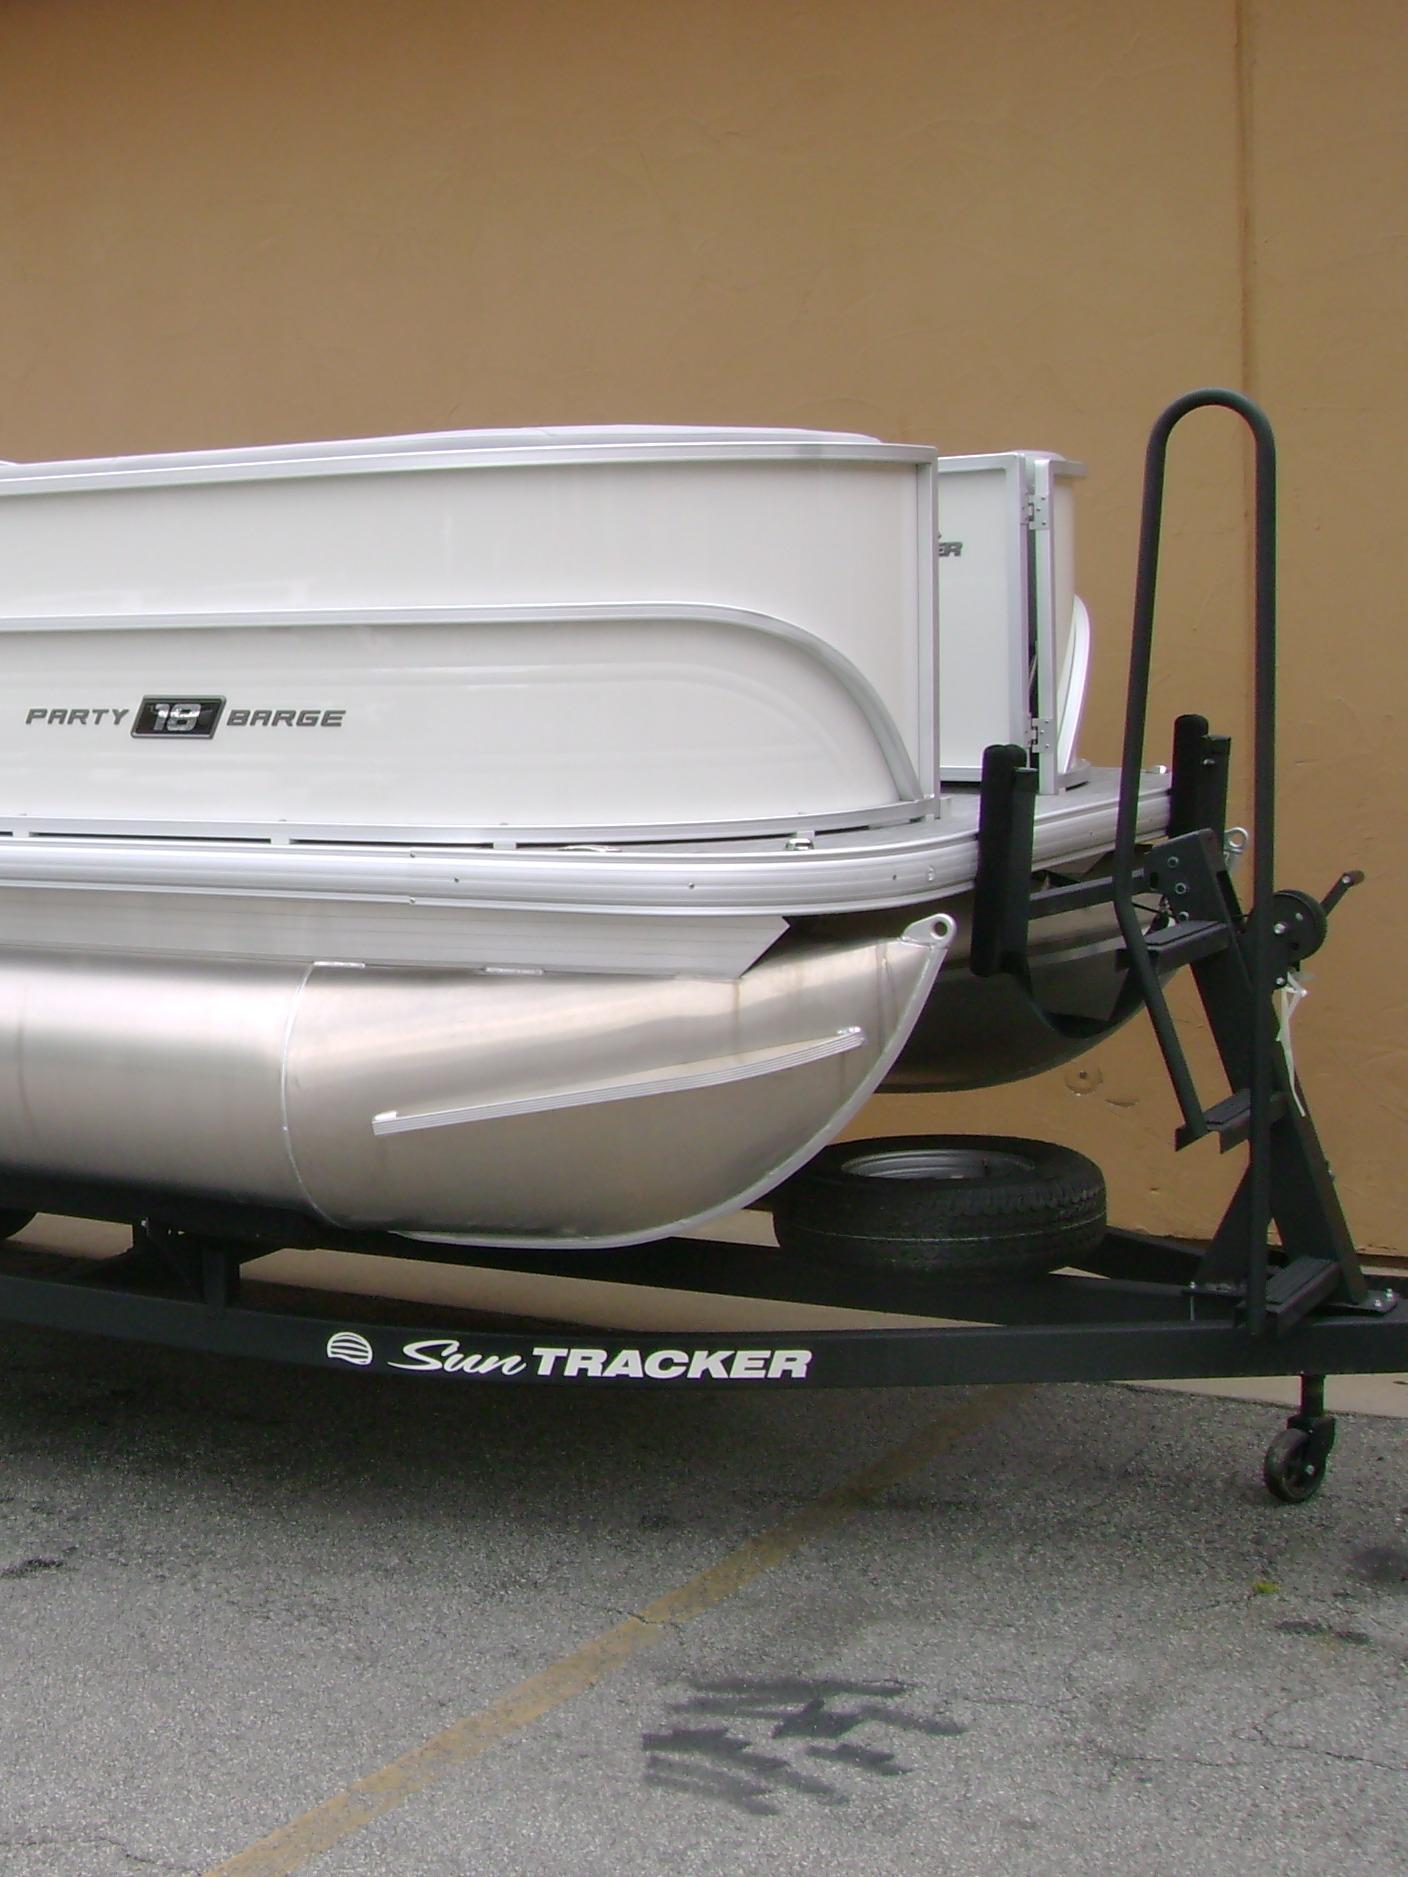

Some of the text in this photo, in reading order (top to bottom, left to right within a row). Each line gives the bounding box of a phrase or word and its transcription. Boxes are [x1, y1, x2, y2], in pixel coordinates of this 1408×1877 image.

[25, 703, 346, 732] PARTY 18 BARGE
[388, 1339, 812, 1379] Sun TRACKER
